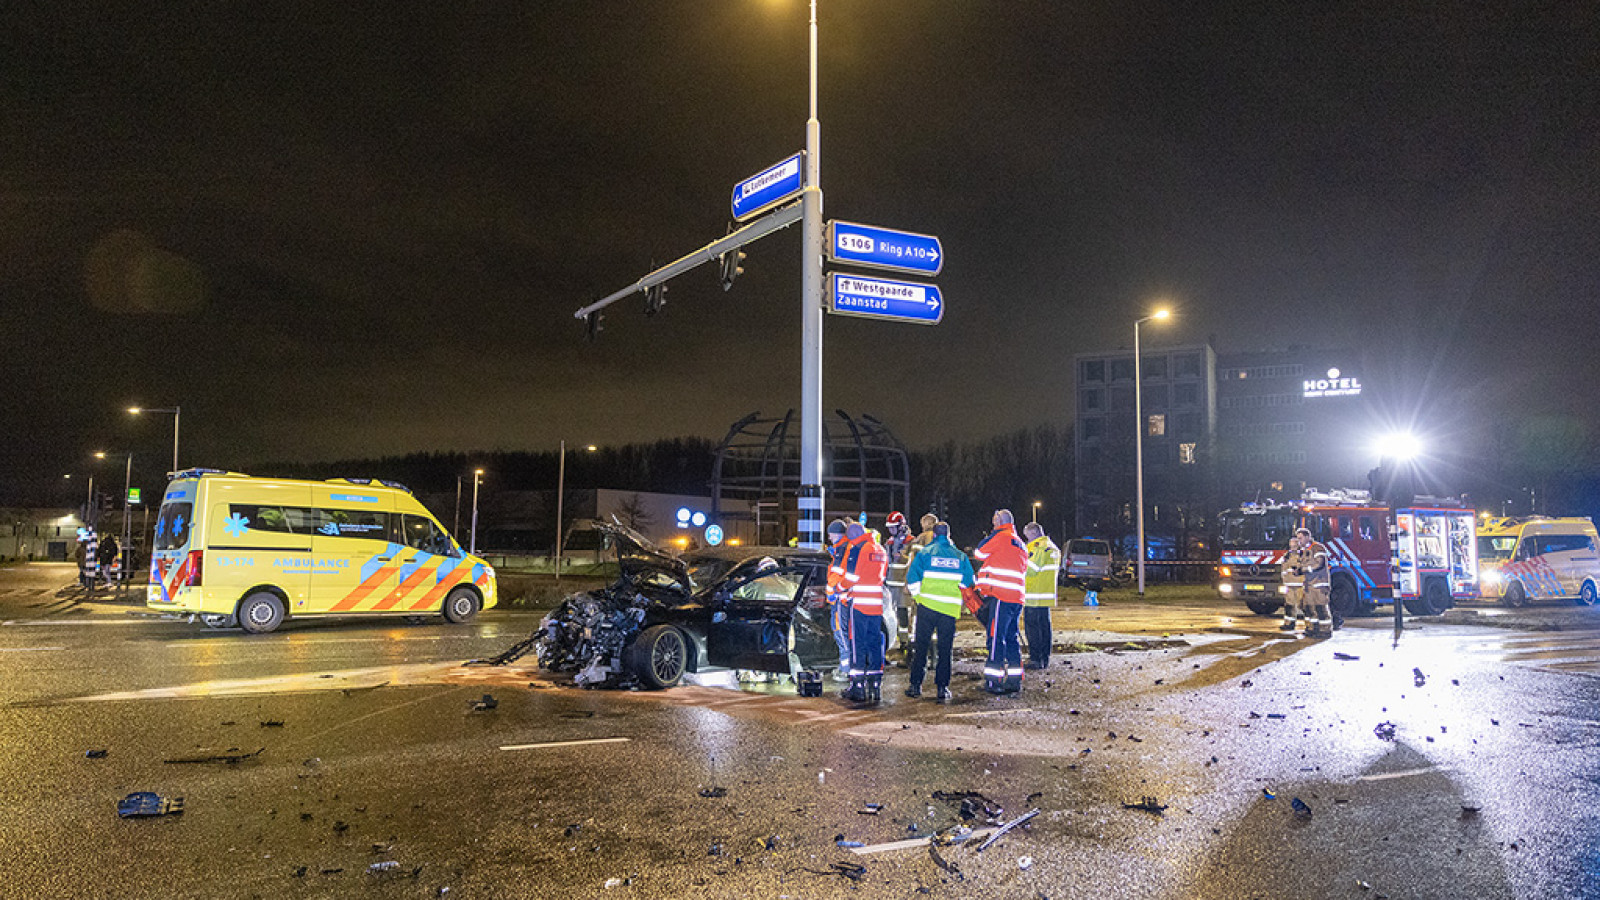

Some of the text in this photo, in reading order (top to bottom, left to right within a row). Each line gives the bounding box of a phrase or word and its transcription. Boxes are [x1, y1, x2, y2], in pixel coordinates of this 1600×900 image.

[841, 237, 926, 258] S 106 Ring A10
[853, 281, 914, 297] Westgaarde
[837, 294, 888, 309] Zaanstad
[1303, 378, 1362, 390] HOTEL
[216, 557, 350, 568] 13-174 AMBULANCE
